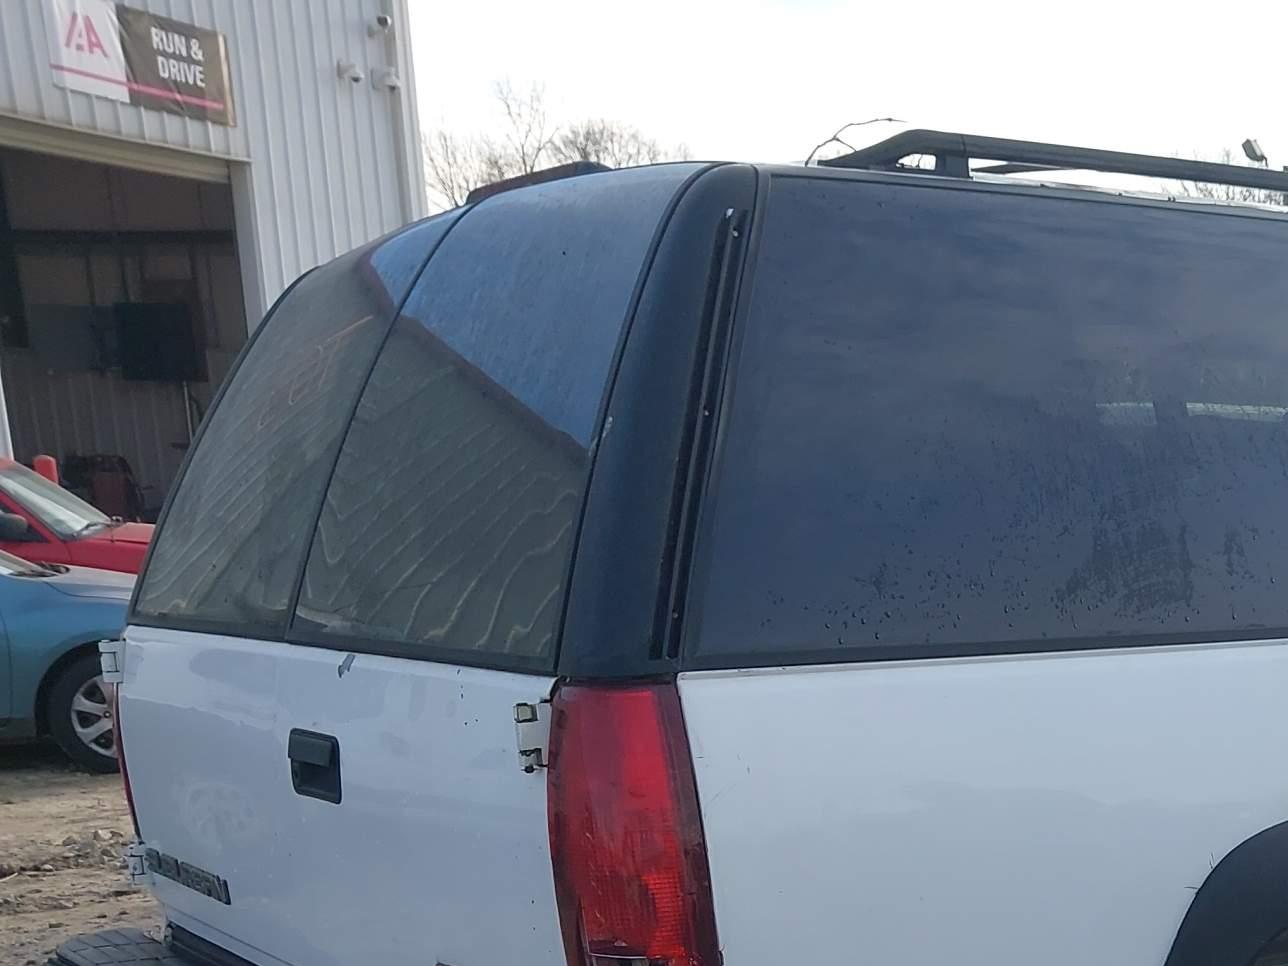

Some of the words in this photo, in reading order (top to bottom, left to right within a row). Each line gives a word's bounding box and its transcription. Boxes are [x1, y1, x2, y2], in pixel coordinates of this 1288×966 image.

[151, 27, 187, 57] RUN
[190, 37, 204, 61] &
[156, 56, 206, 88] DRIVE
